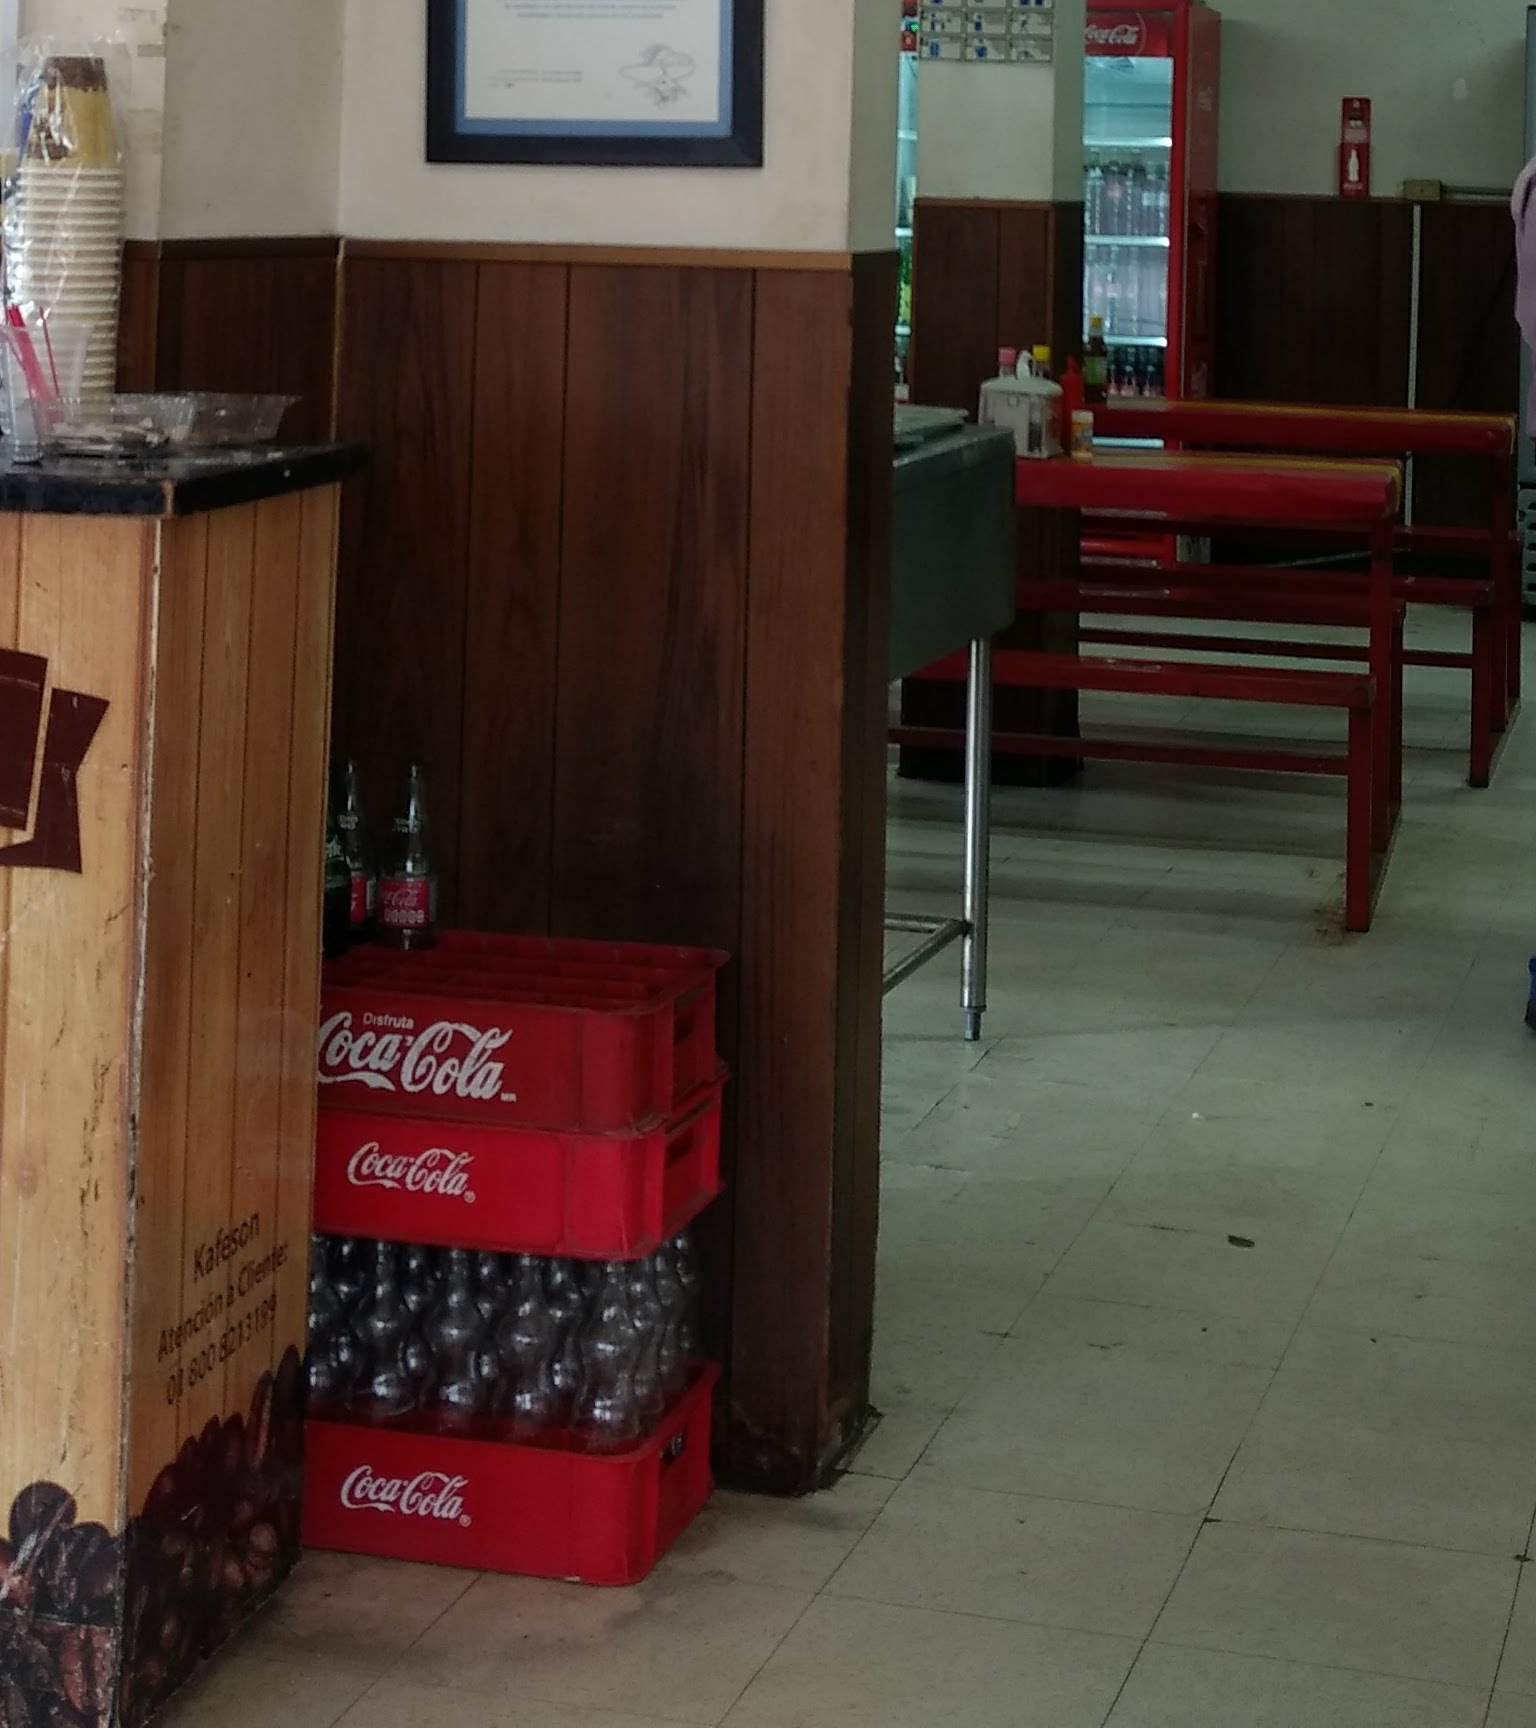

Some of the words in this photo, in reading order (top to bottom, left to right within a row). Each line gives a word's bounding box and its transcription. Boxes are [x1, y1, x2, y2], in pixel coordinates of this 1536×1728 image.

[363, 1012, 414, 1031] Disfruta
[318, 1011, 512, 1102] Coca-Cola
[347, 1141, 474, 1196] Coca-Cola
[193, 1212, 260, 1282] Kafeson
[340, 1464, 468, 1520] Coca-Cola
